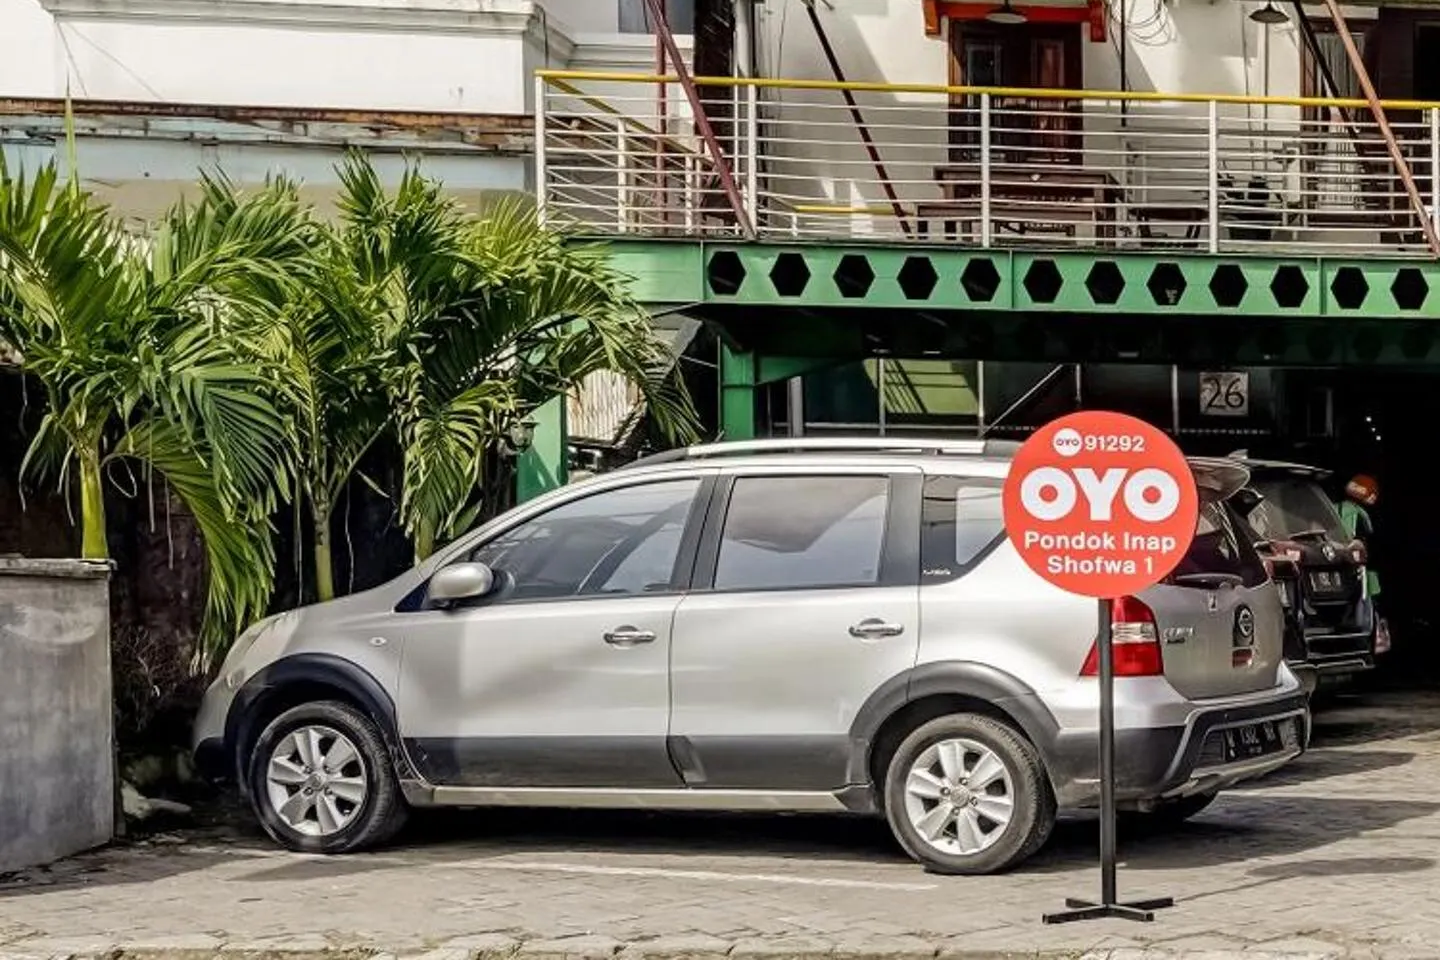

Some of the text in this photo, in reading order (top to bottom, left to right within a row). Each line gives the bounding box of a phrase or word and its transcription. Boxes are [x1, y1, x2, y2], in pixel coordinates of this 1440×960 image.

[1202, 377, 1244, 409] 26
[1084, 435, 1145, 452] 91292
[1020, 466, 1180, 522] OYO
[1024, 531, 1176, 554] Pondok Inap
[1047, 556, 1153, 575] Shofwa 1
